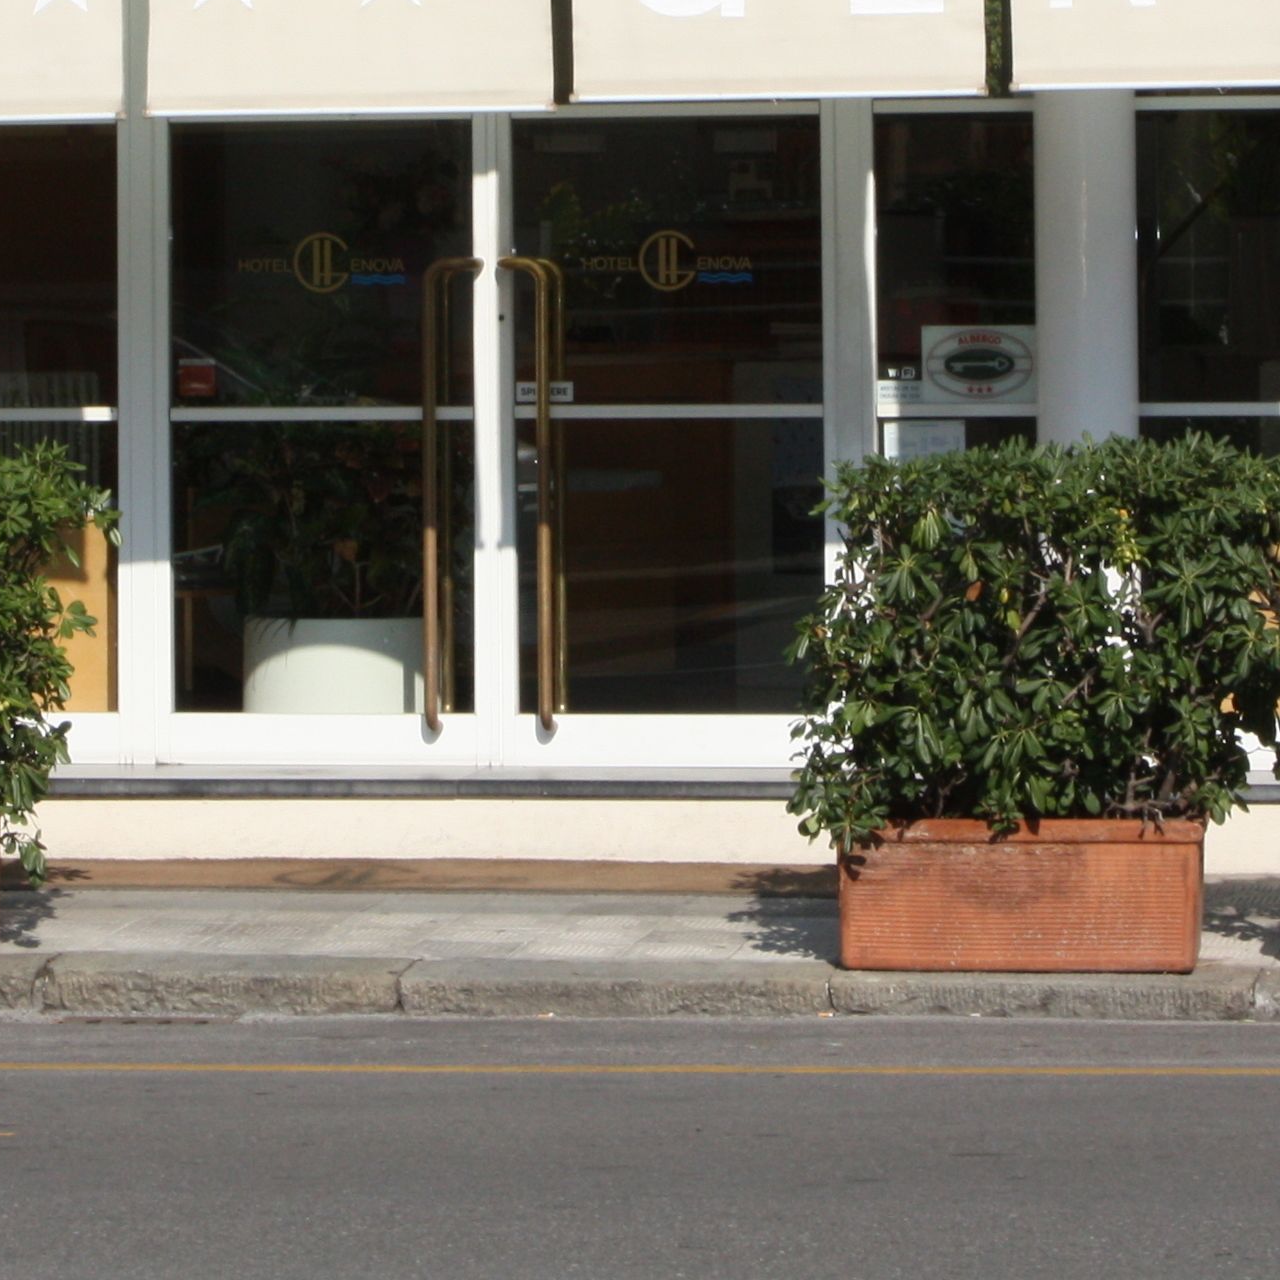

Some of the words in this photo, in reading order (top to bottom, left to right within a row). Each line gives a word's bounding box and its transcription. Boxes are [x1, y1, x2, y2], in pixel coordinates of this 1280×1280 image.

[237, 257, 292, 273] HOTEL
[582, 256, 638, 271] HOTEL
[957, 334, 1002, 346] ALBERGO
[520, 386, 569, 396] SPIERE
